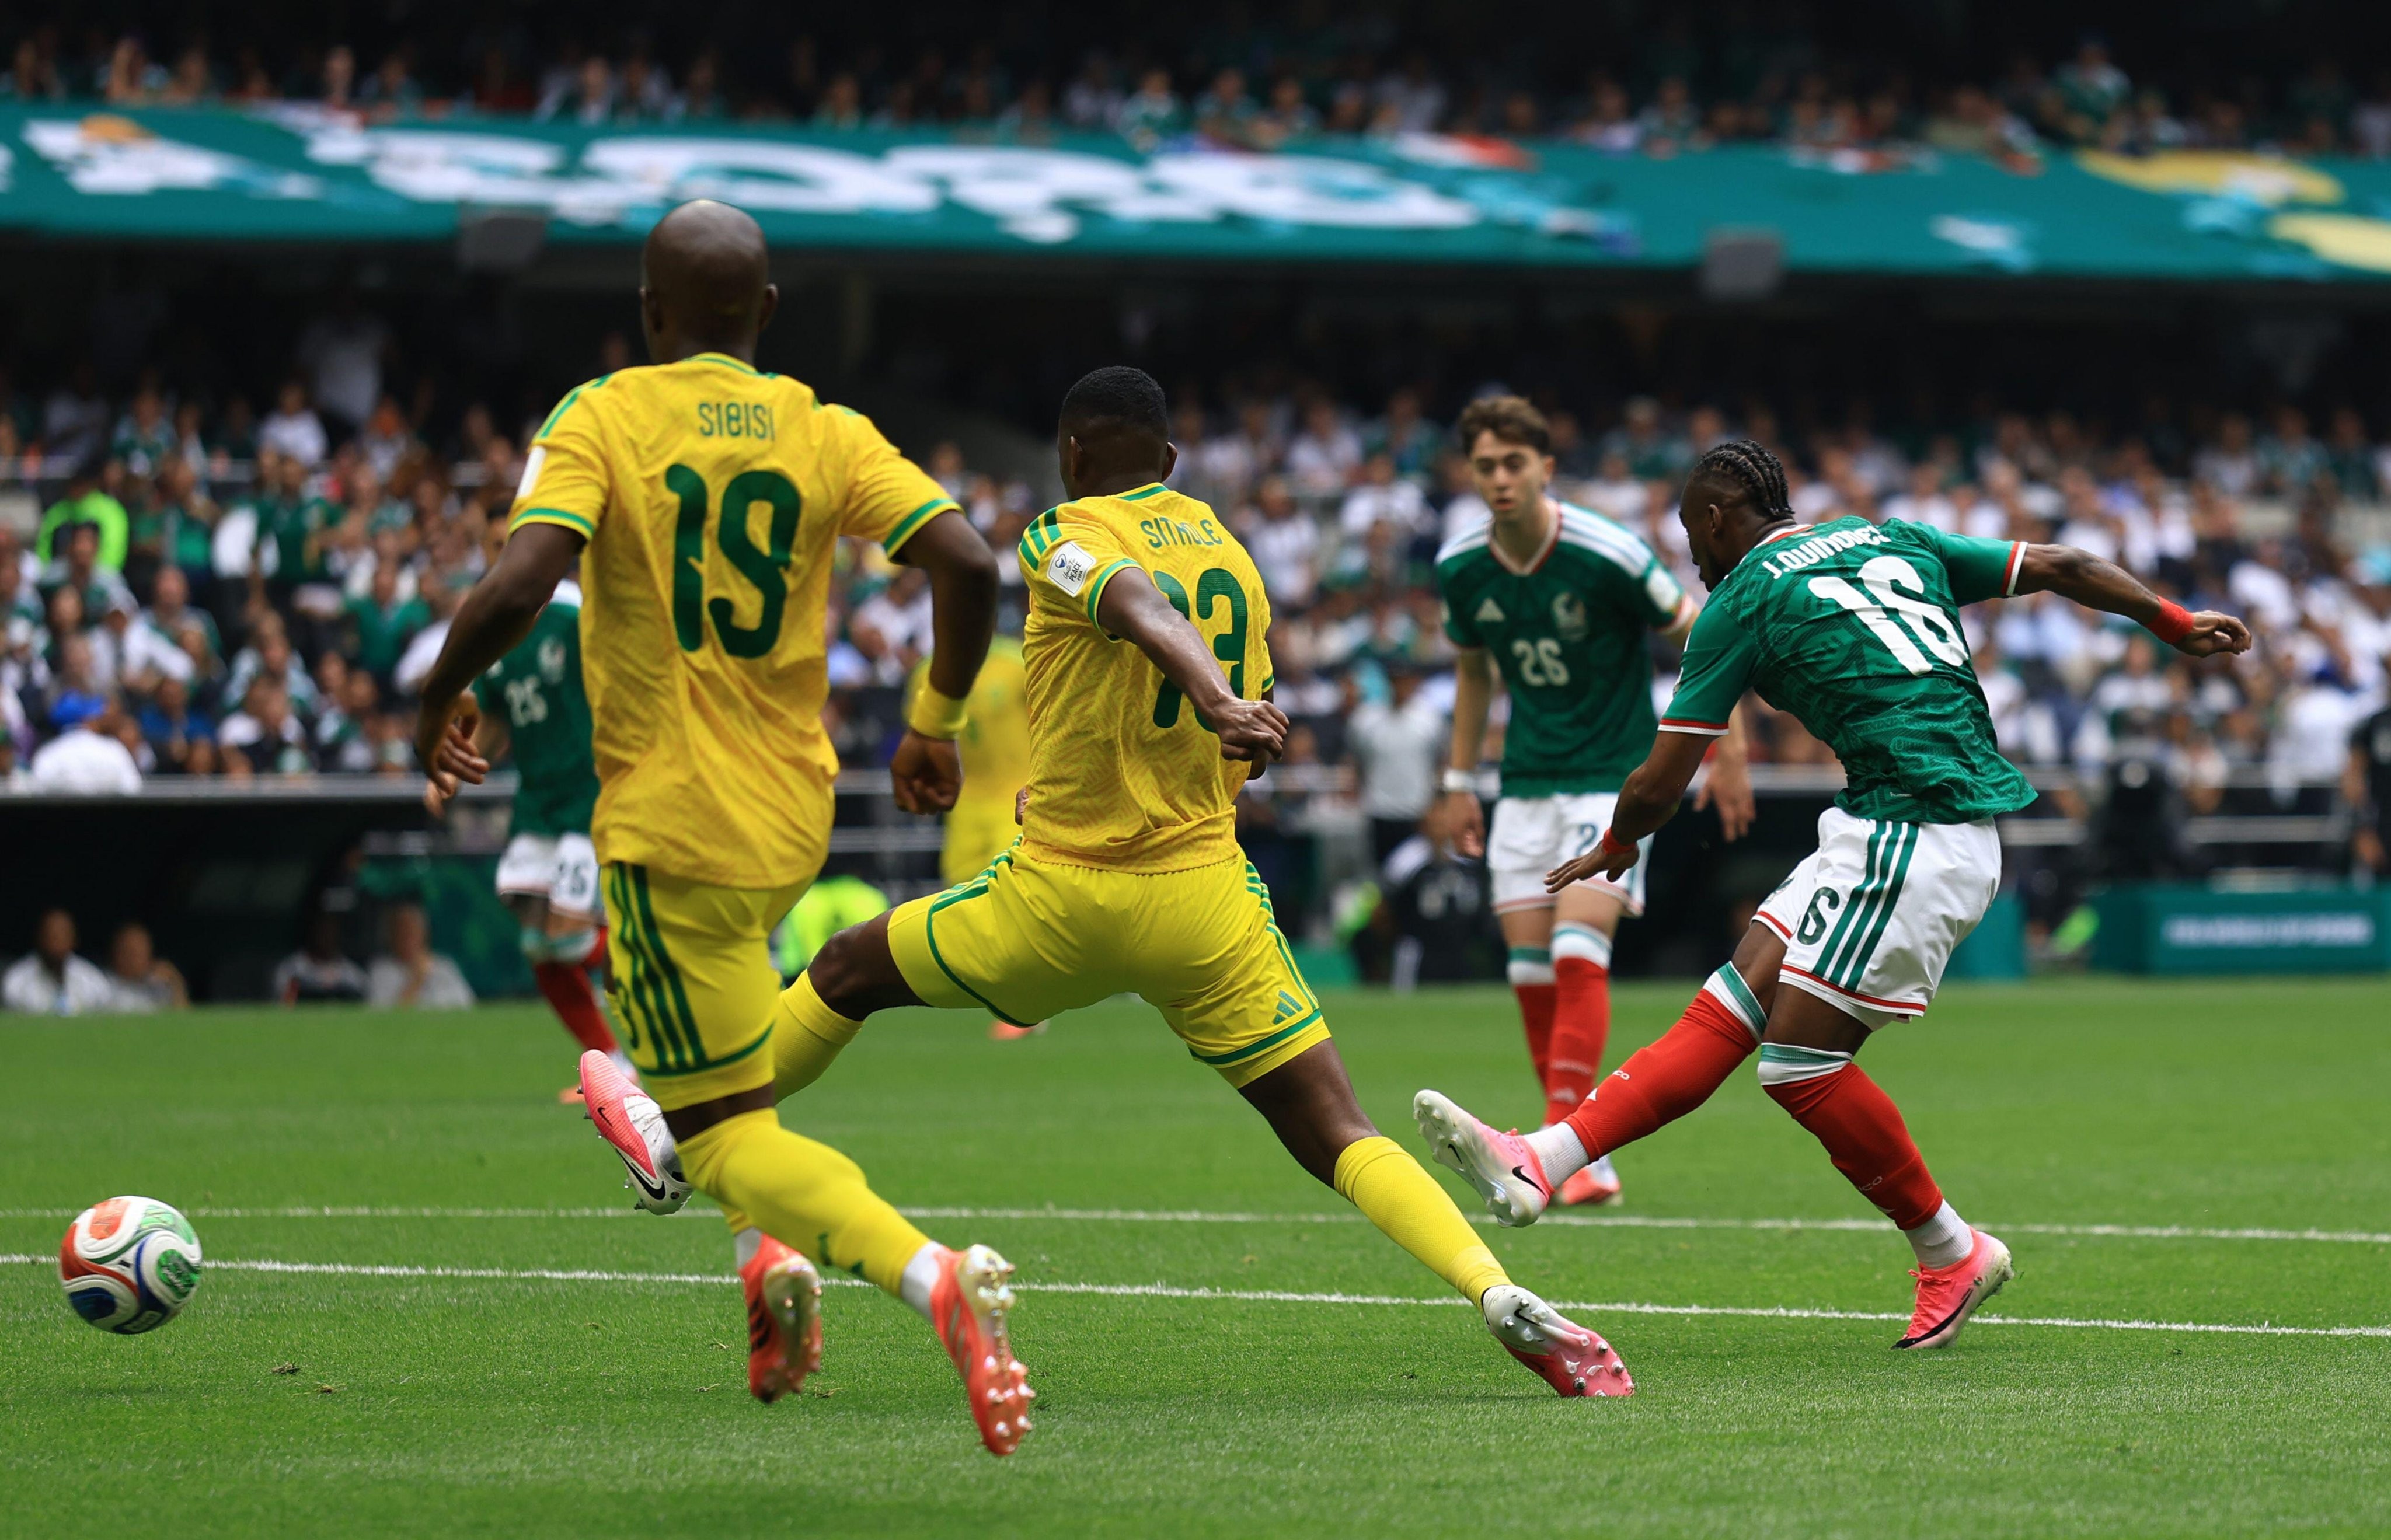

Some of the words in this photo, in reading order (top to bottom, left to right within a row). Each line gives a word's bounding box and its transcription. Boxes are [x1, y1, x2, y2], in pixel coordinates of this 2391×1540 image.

[699, 402, 775, 441] SIBISI
[665, 464, 802, 658] 19
[1069, 561, 1082, 582] PEACE
[1808, 556, 1968, 676] 16
[1512, 638, 1570, 686] 26
